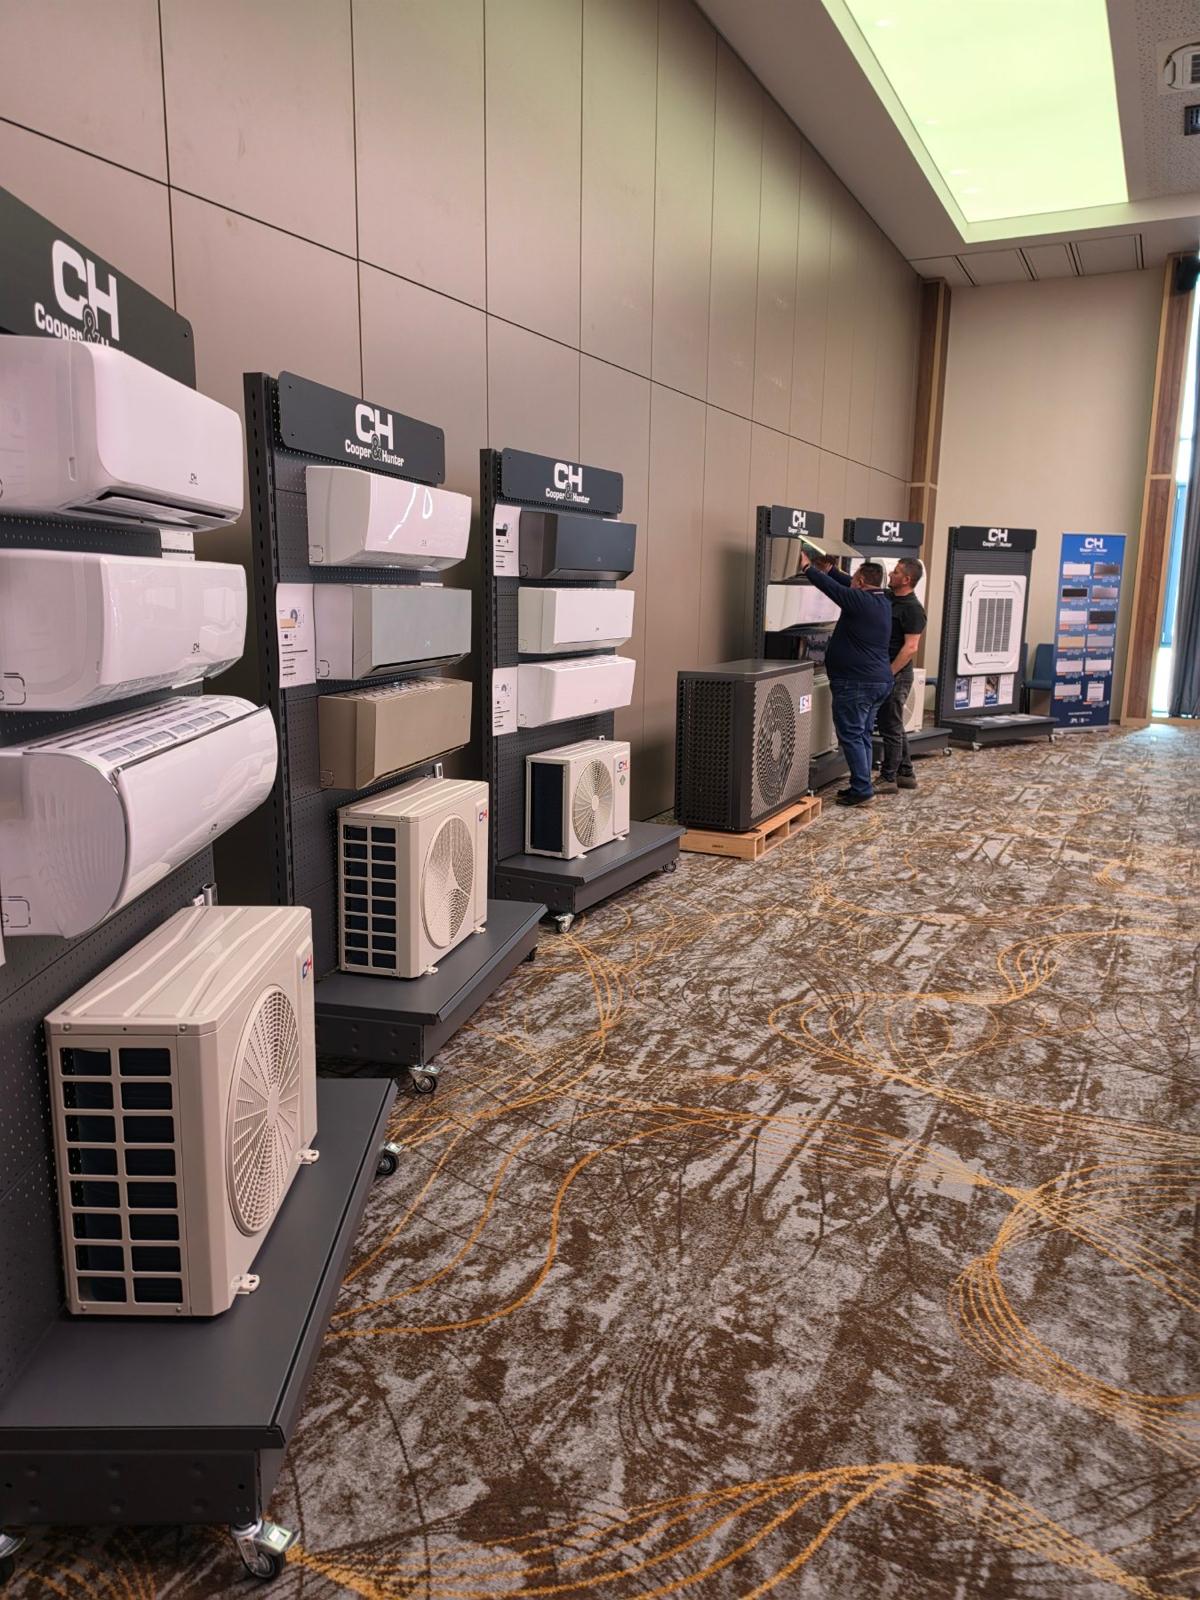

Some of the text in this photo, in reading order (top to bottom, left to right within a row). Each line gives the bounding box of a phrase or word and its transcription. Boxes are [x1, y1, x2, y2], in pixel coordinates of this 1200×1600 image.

[52, 239, 120, 342] CH
[355, 403, 394, 450] CH
[344, 438, 371, 460] Cooper
[381, 449, 405, 468] Hunter
[554, 462, 583, 493] CH
[792, 510, 806, 529] CH
[882, 521, 900, 537] CH
[988, 528, 1008, 542] CH
[1085, 537, 1104, 549] CH
